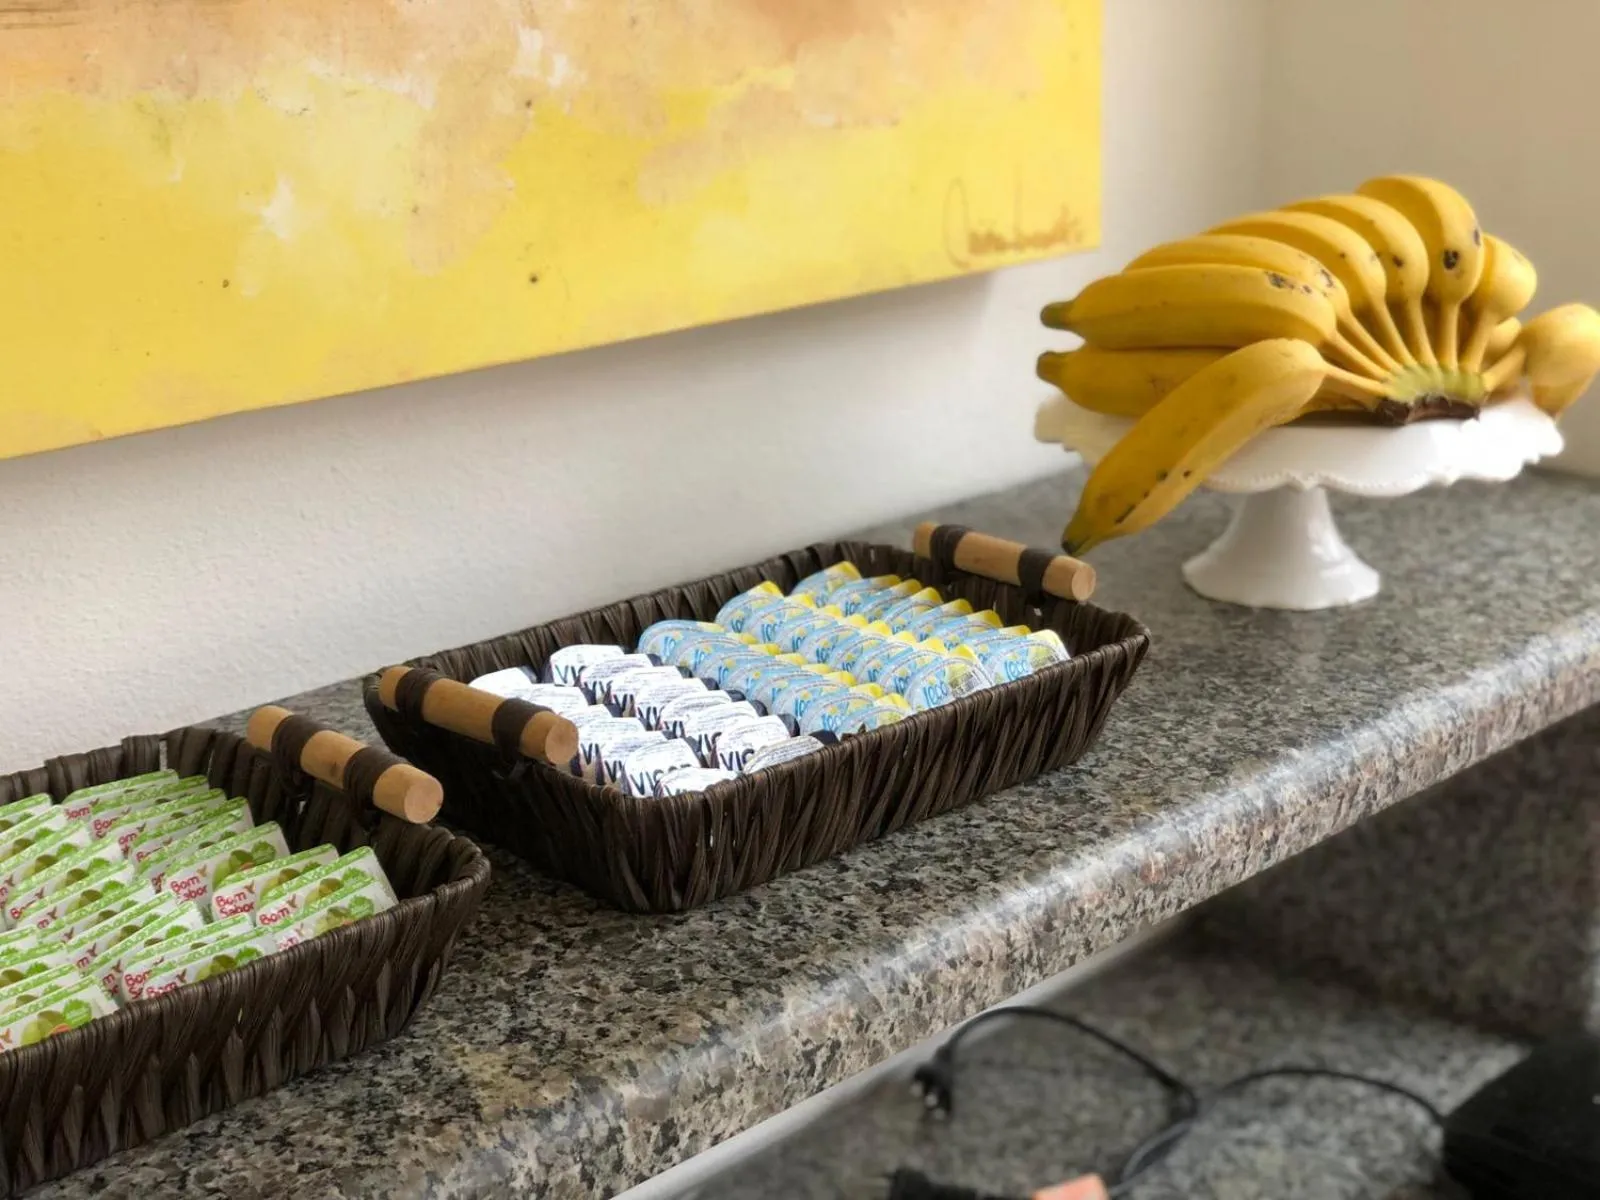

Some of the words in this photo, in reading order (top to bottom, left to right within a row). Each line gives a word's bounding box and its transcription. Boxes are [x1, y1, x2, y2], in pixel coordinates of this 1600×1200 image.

[170, 876, 199, 892] Bom
[215, 892, 246, 907] Bom
[259, 907, 290, 925] Bom
